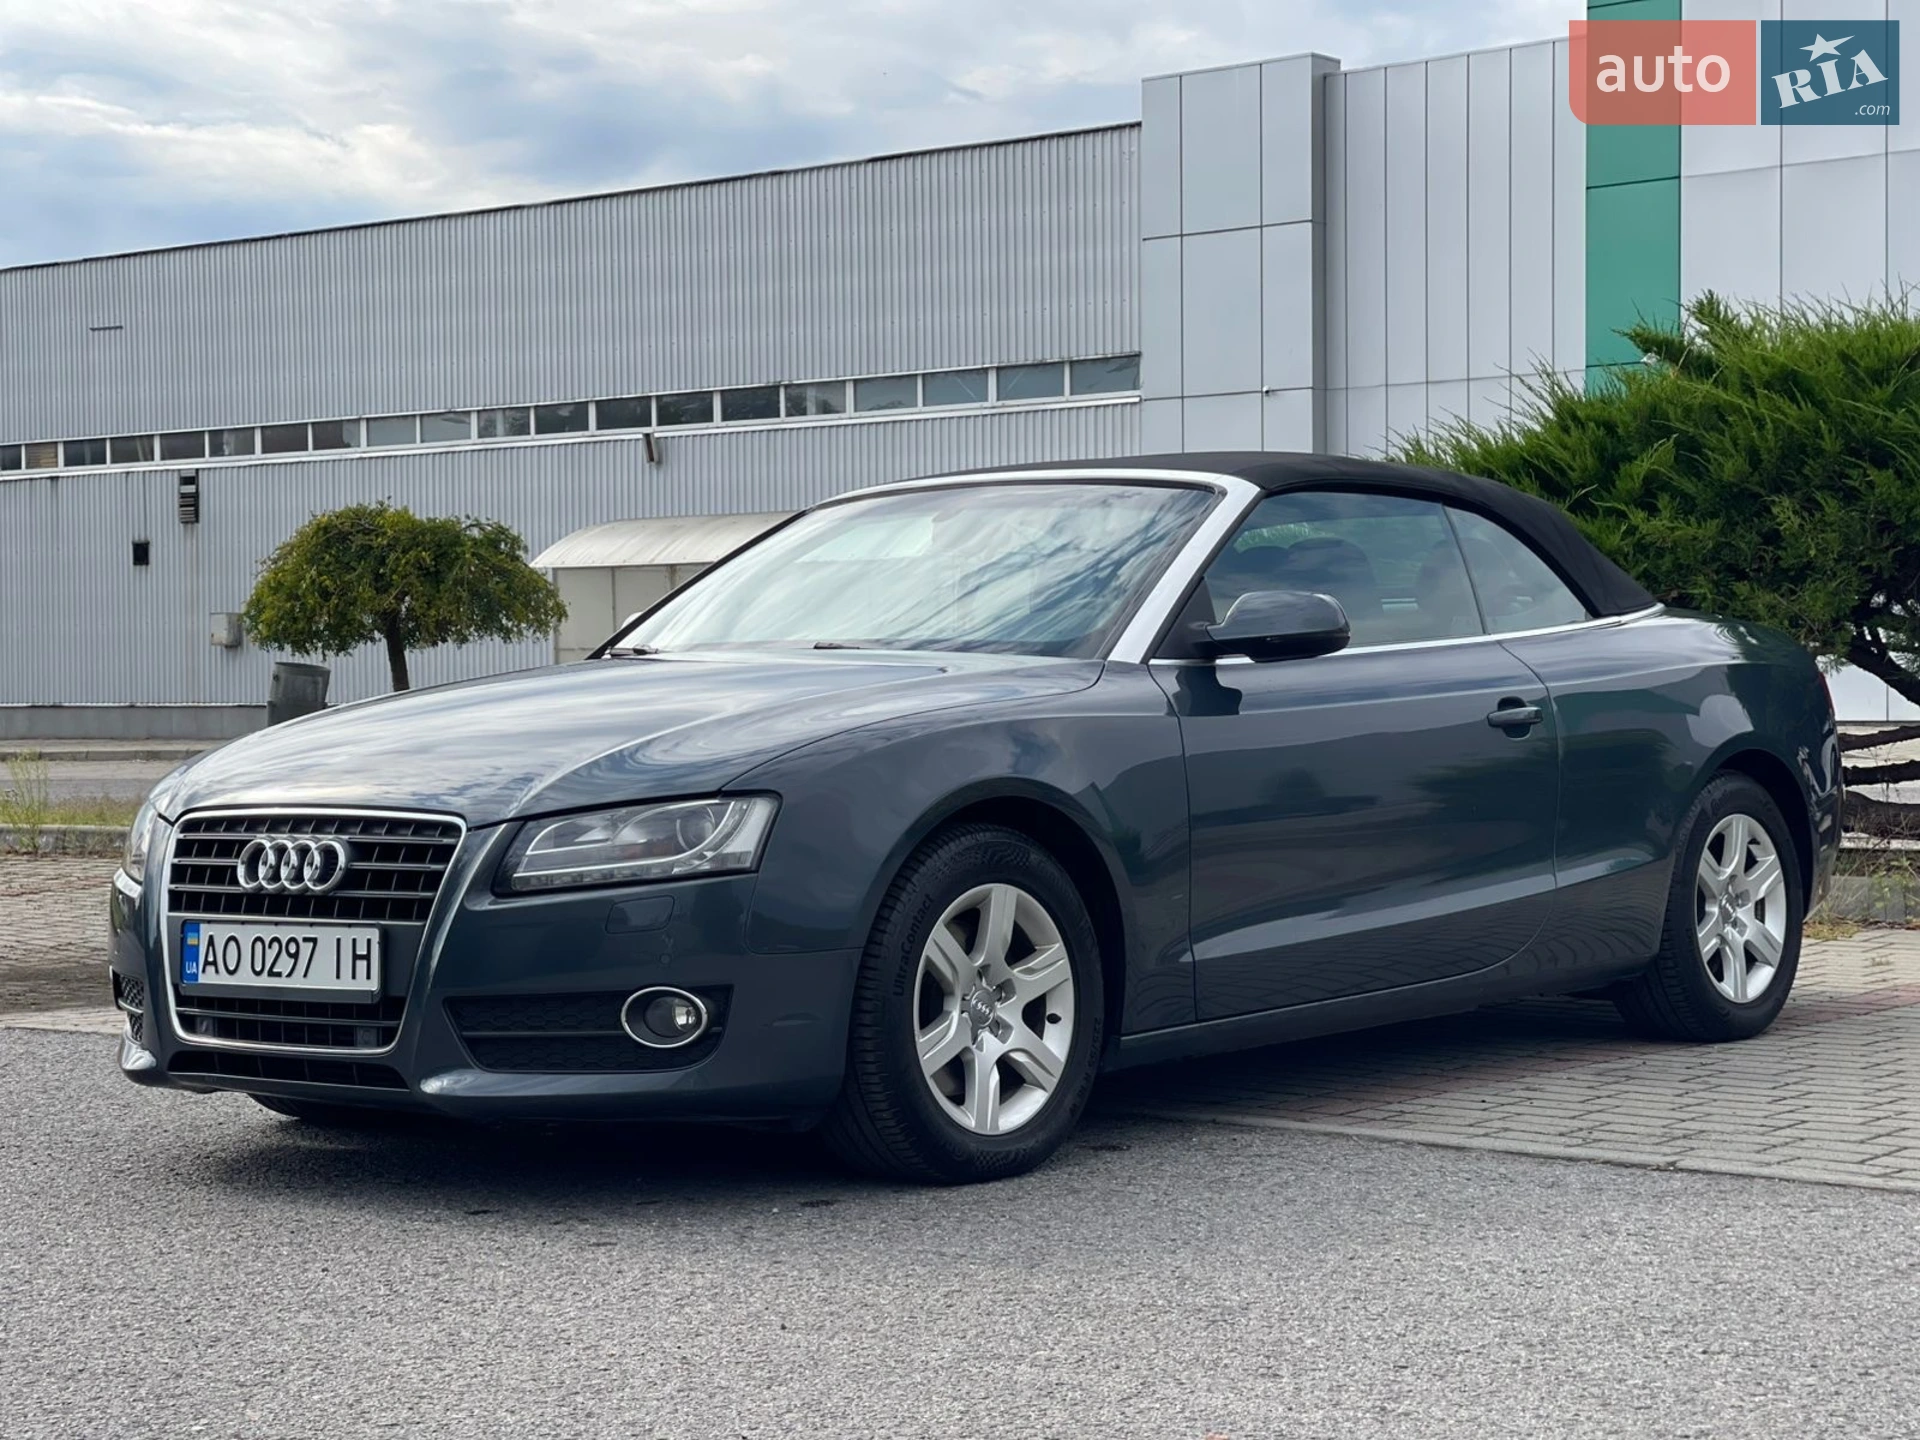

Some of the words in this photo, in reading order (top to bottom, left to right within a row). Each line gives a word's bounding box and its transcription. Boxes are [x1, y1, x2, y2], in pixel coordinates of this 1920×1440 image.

[185, 961, 197, 974] UA
[201, 934, 241, 976] AO
[250, 935, 318, 978] 0297
[335, 937, 371, 980] IH
[893, 893, 933, 997] UltraContact
